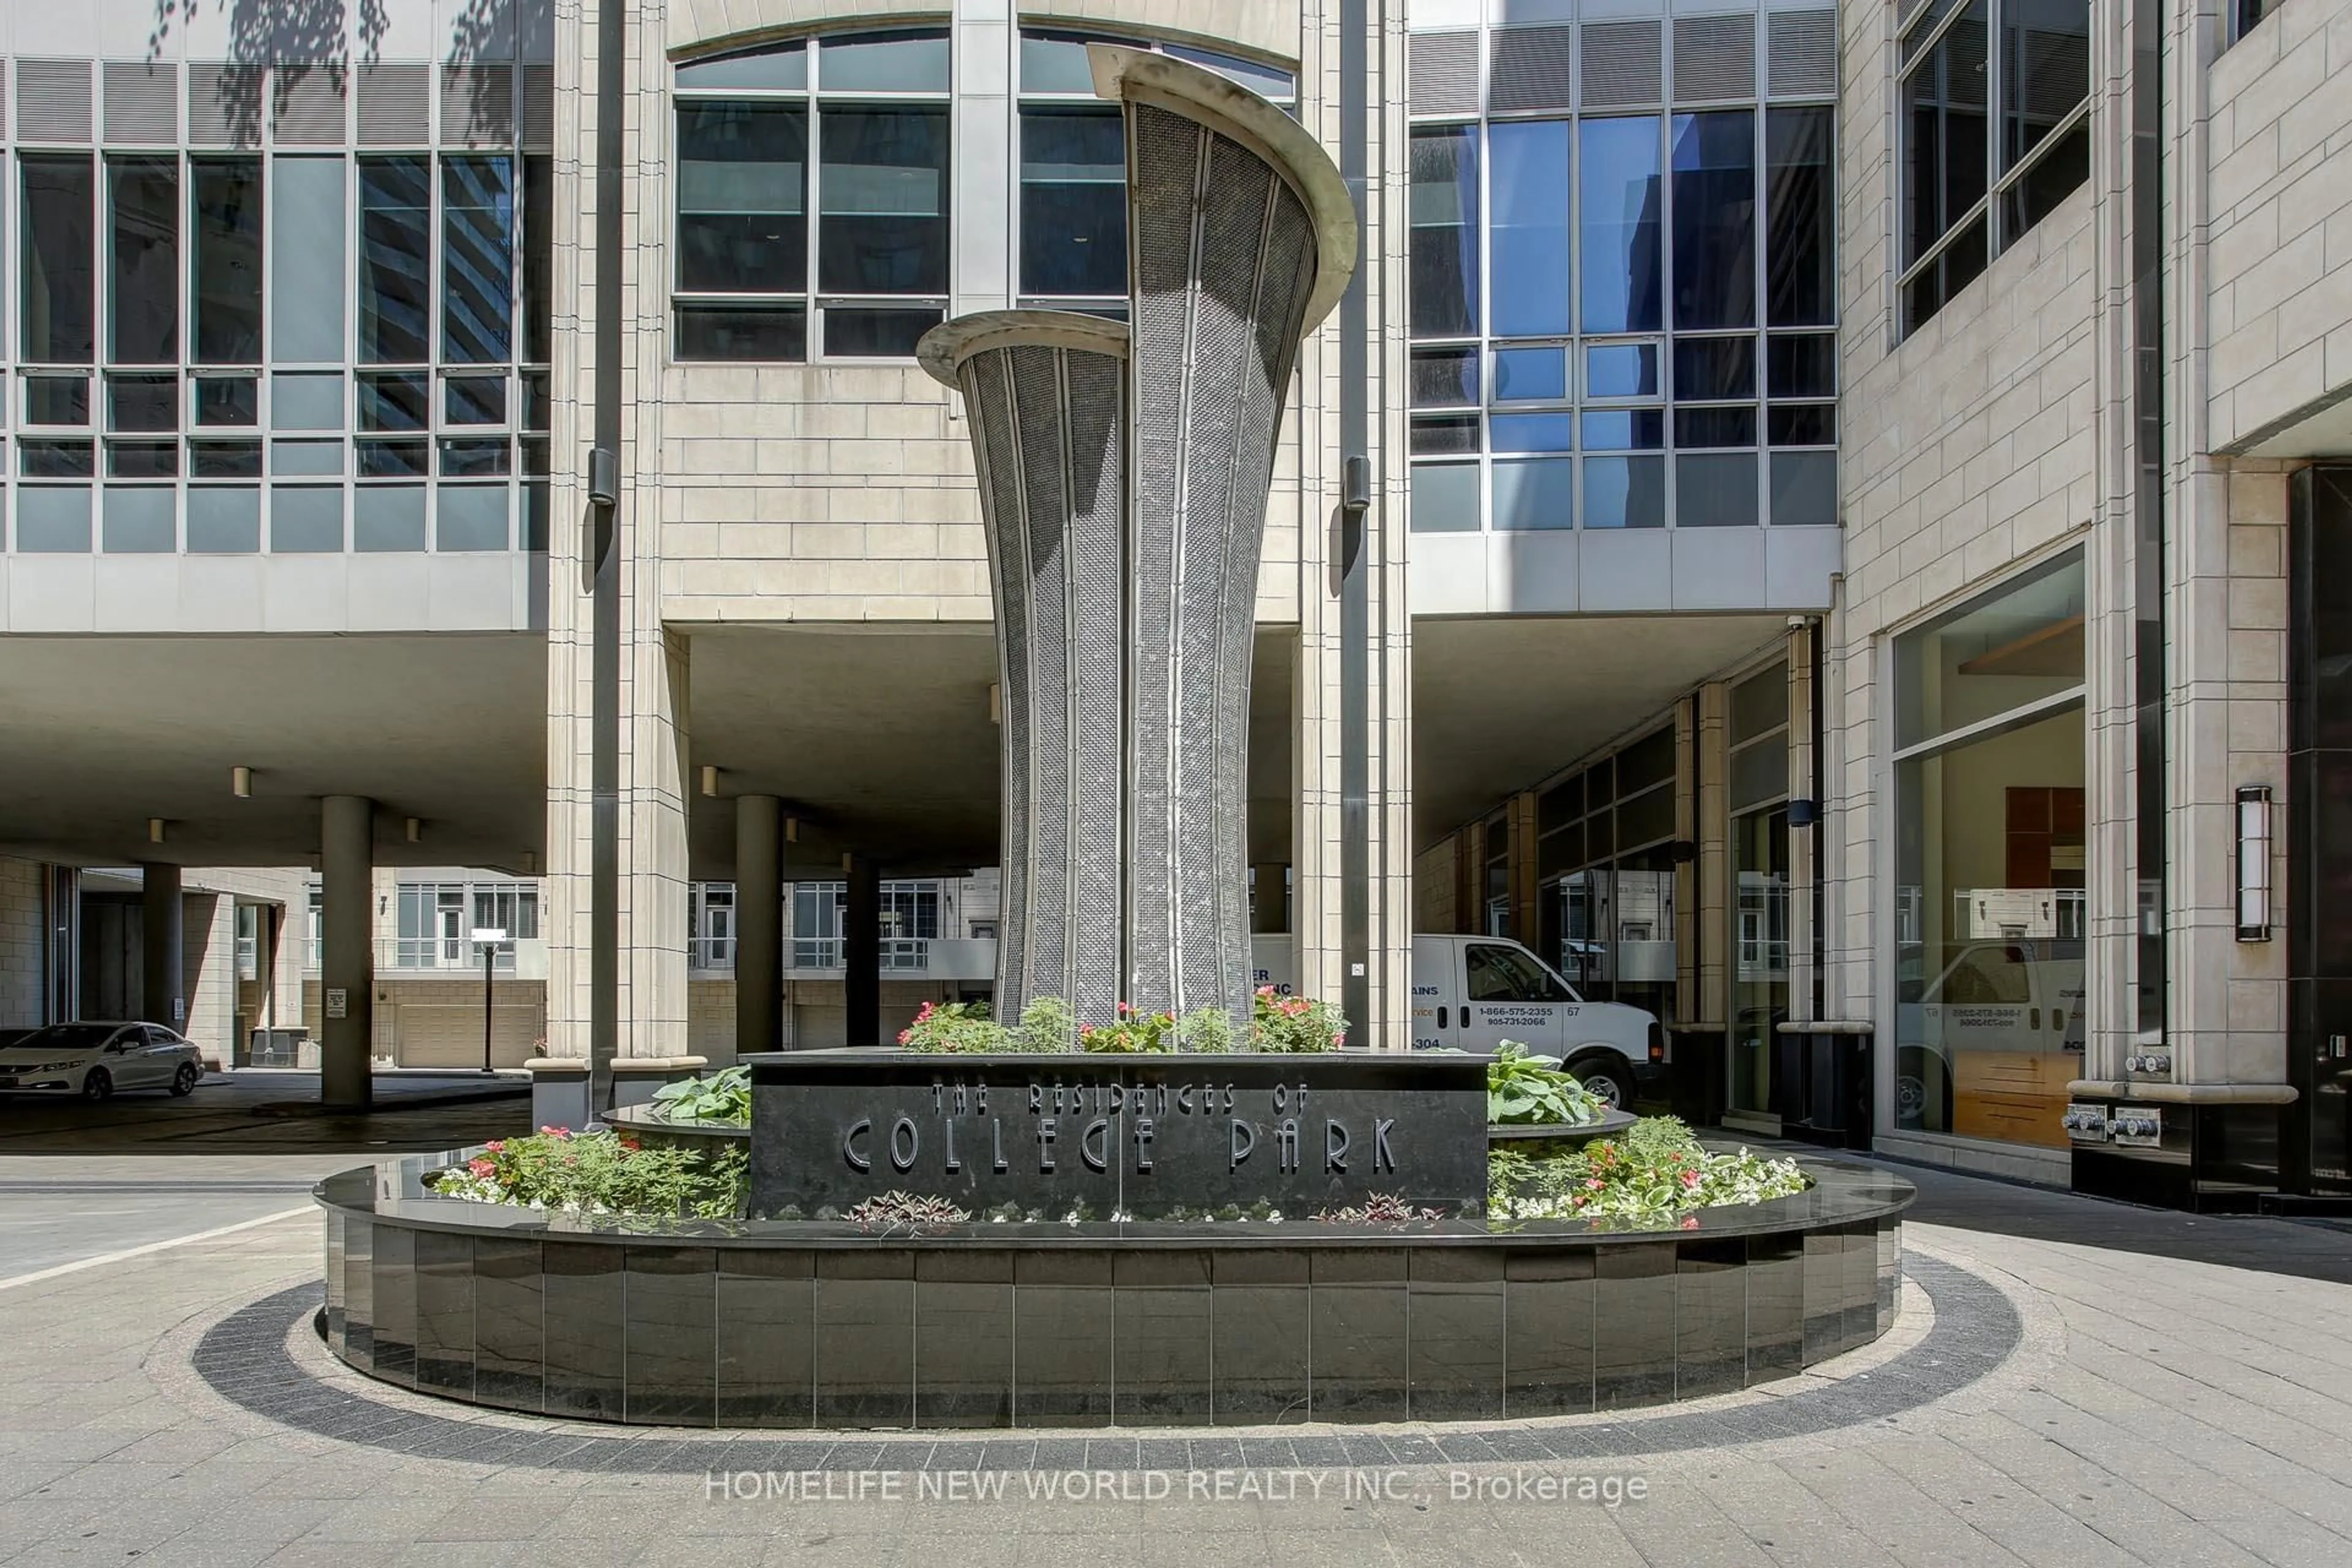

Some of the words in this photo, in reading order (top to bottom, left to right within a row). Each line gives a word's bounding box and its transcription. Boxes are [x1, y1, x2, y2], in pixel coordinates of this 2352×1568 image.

[1264, 983, 1292, 995] NC
[1480, 1007, 1553, 1016] 1-866-575-2355
[1567, 1006, 1580, 1016] 67
[1488, 1017, 1546, 1026] 905-731-2066
[932, 1084, 987, 1109] THE
[1029, 1083, 1235, 1109] RESIDENCES
[1273, 1082, 1308, 1109] OF
[844, 1117, 1154, 1167] COLLEGE
[1231, 1118, 1396, 1167] PARK
